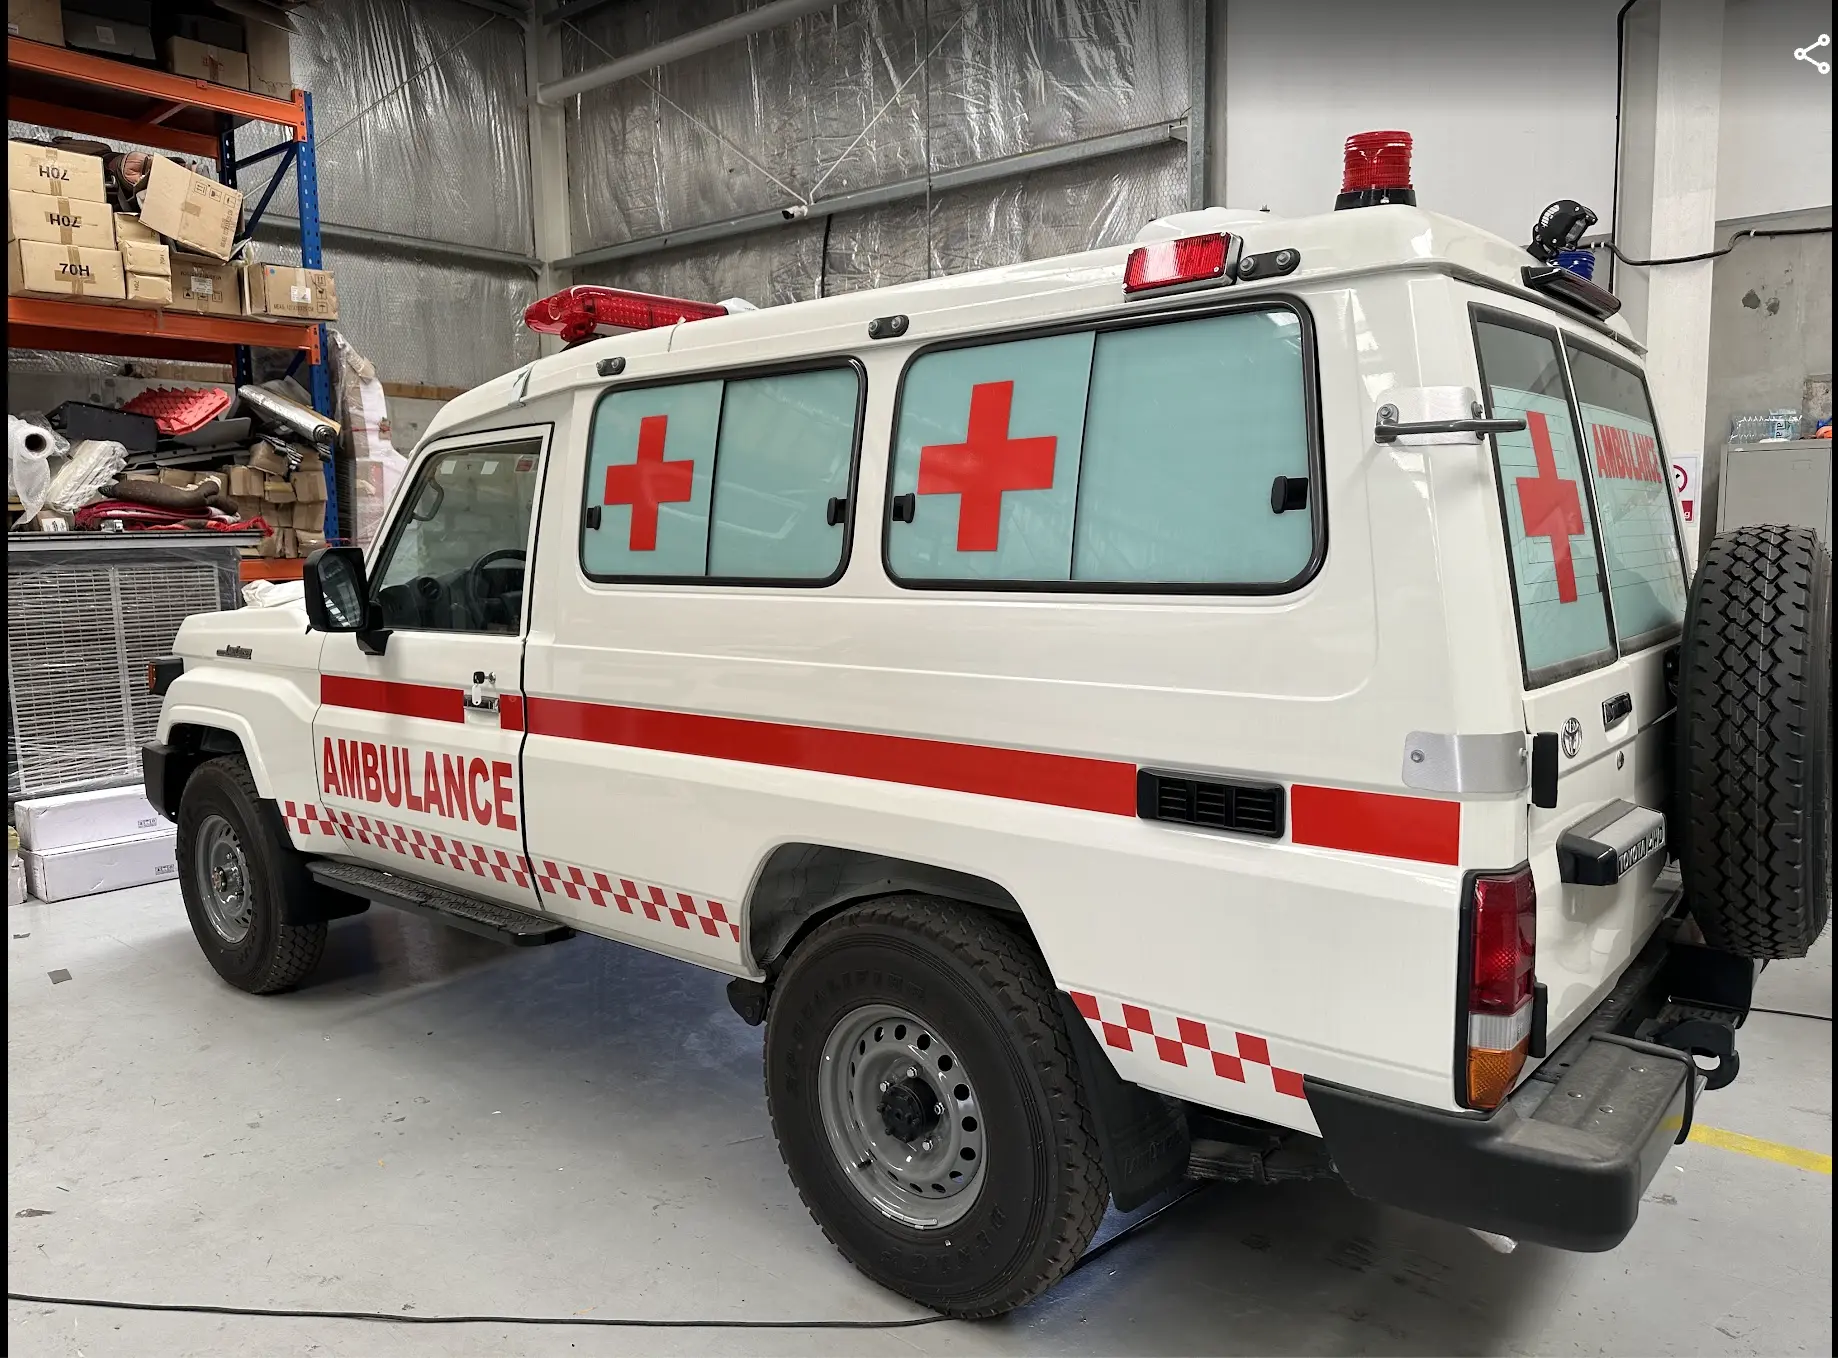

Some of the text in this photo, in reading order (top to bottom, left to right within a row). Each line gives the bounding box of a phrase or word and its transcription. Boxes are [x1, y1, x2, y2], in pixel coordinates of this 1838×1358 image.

[39, 165, 69, 181] 70H
[50, 213, 80, 228] 70H
[59, 263, 90, 277] 70H
[1592, 424, 1662, 484] AMBULANCE
[324, 737, 517, 831] AMBULANCE
[1619, 827, 1664, 874] TOYOTA 4WD
